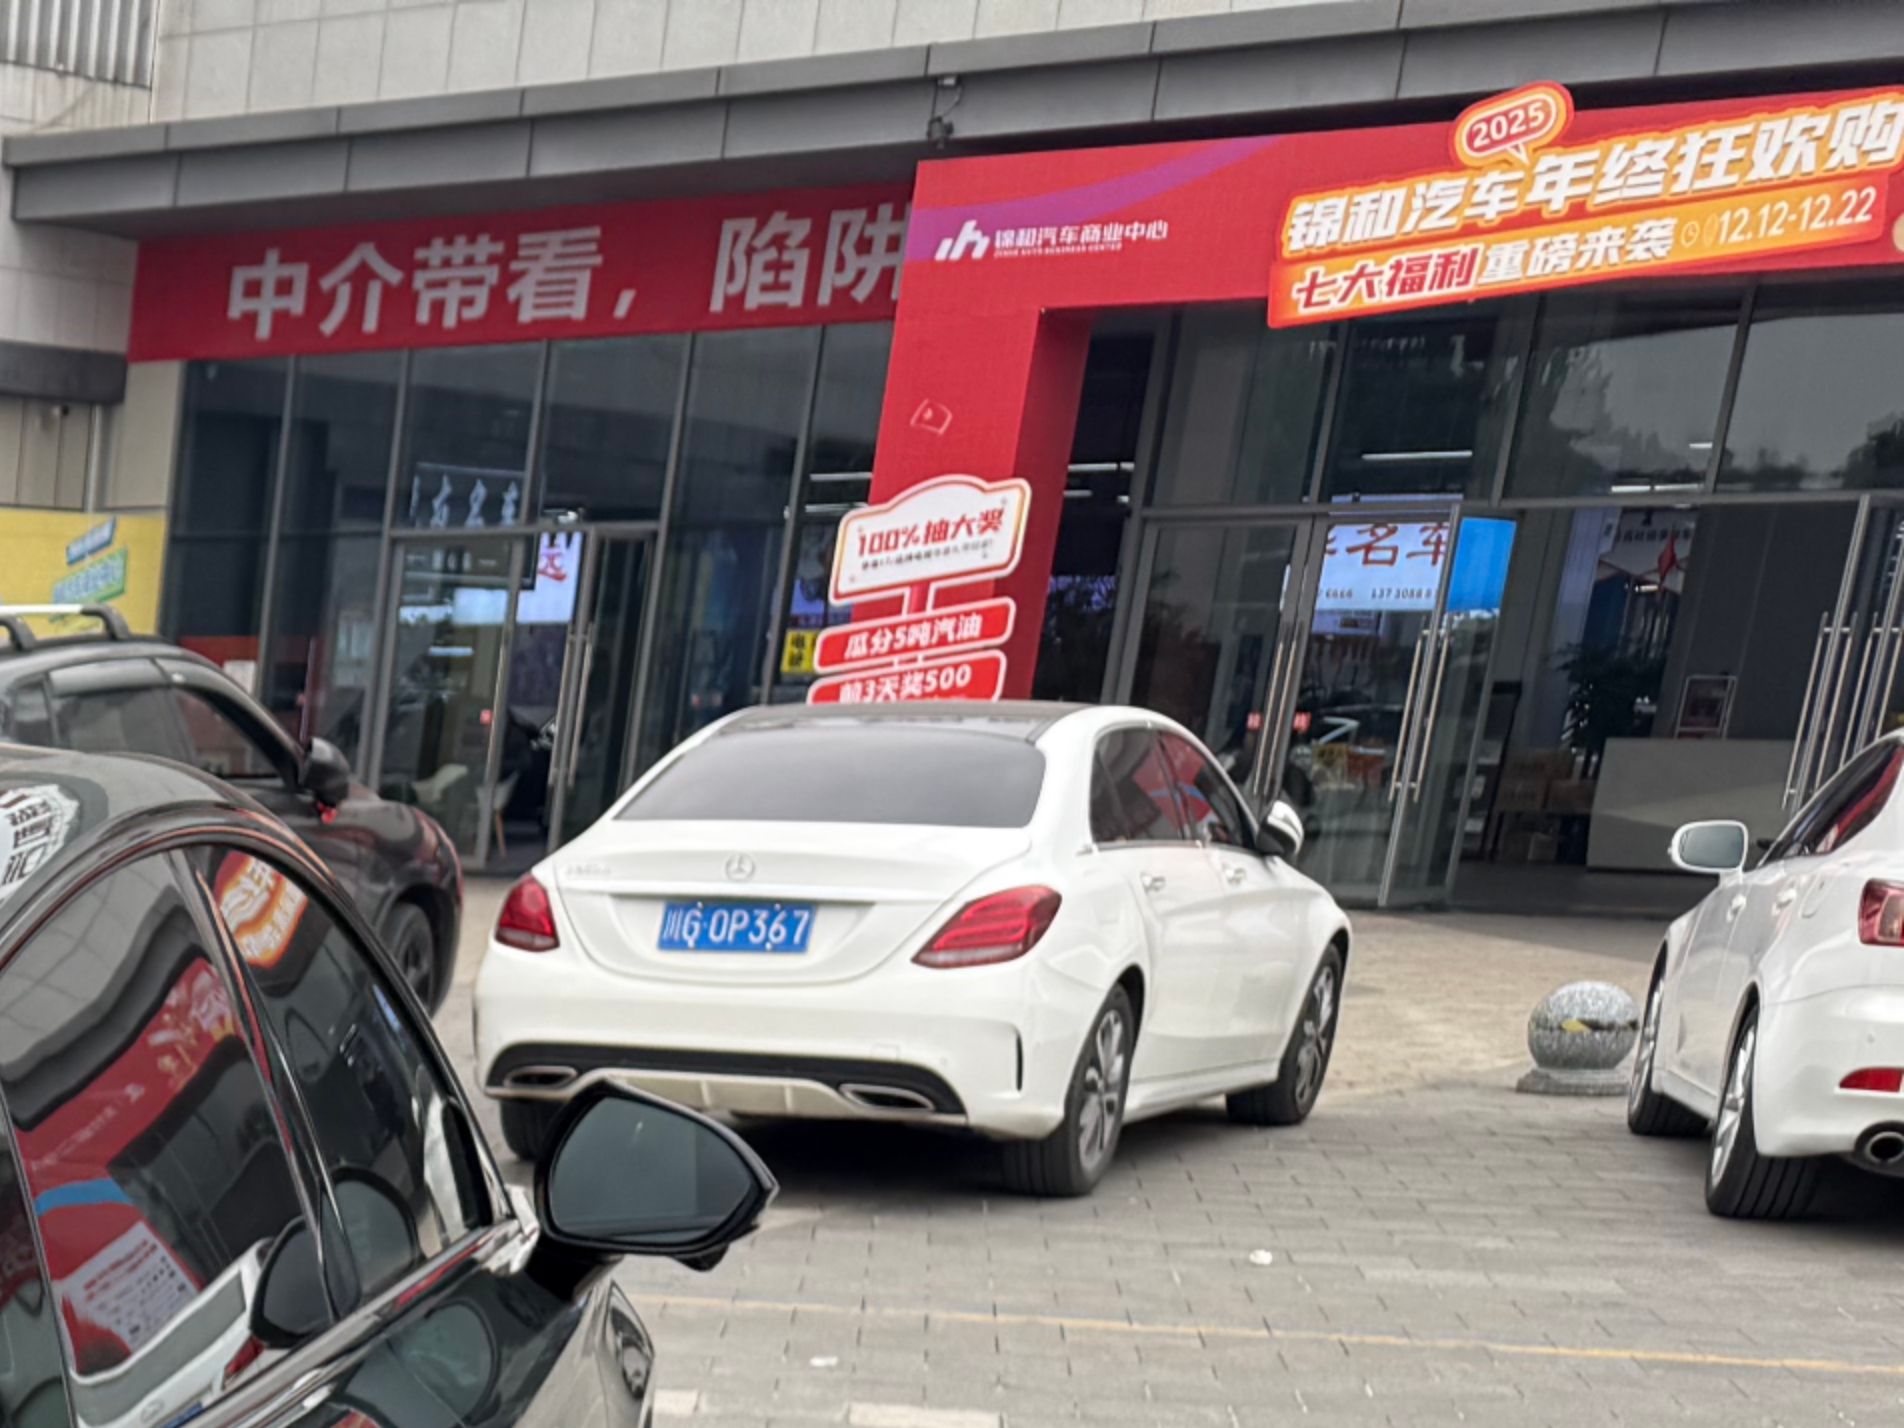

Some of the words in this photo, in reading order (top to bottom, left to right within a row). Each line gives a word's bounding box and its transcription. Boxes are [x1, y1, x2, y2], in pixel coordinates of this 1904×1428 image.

[1471, 101, 1547, 147] 2025
[1286, 96, 1904, 252] 锦和汽车年终狂欢购
[994, 219, 1169, 249] 锦和汽车商业中心
[1718, 186, 1877, 245] 12.12-12.22
[708, 200, 910, 313] 陷阱
[857, 507, 1004, 558] 100%抽大奖
[843, 612, 983, 660] 瓜分5吨汽油
